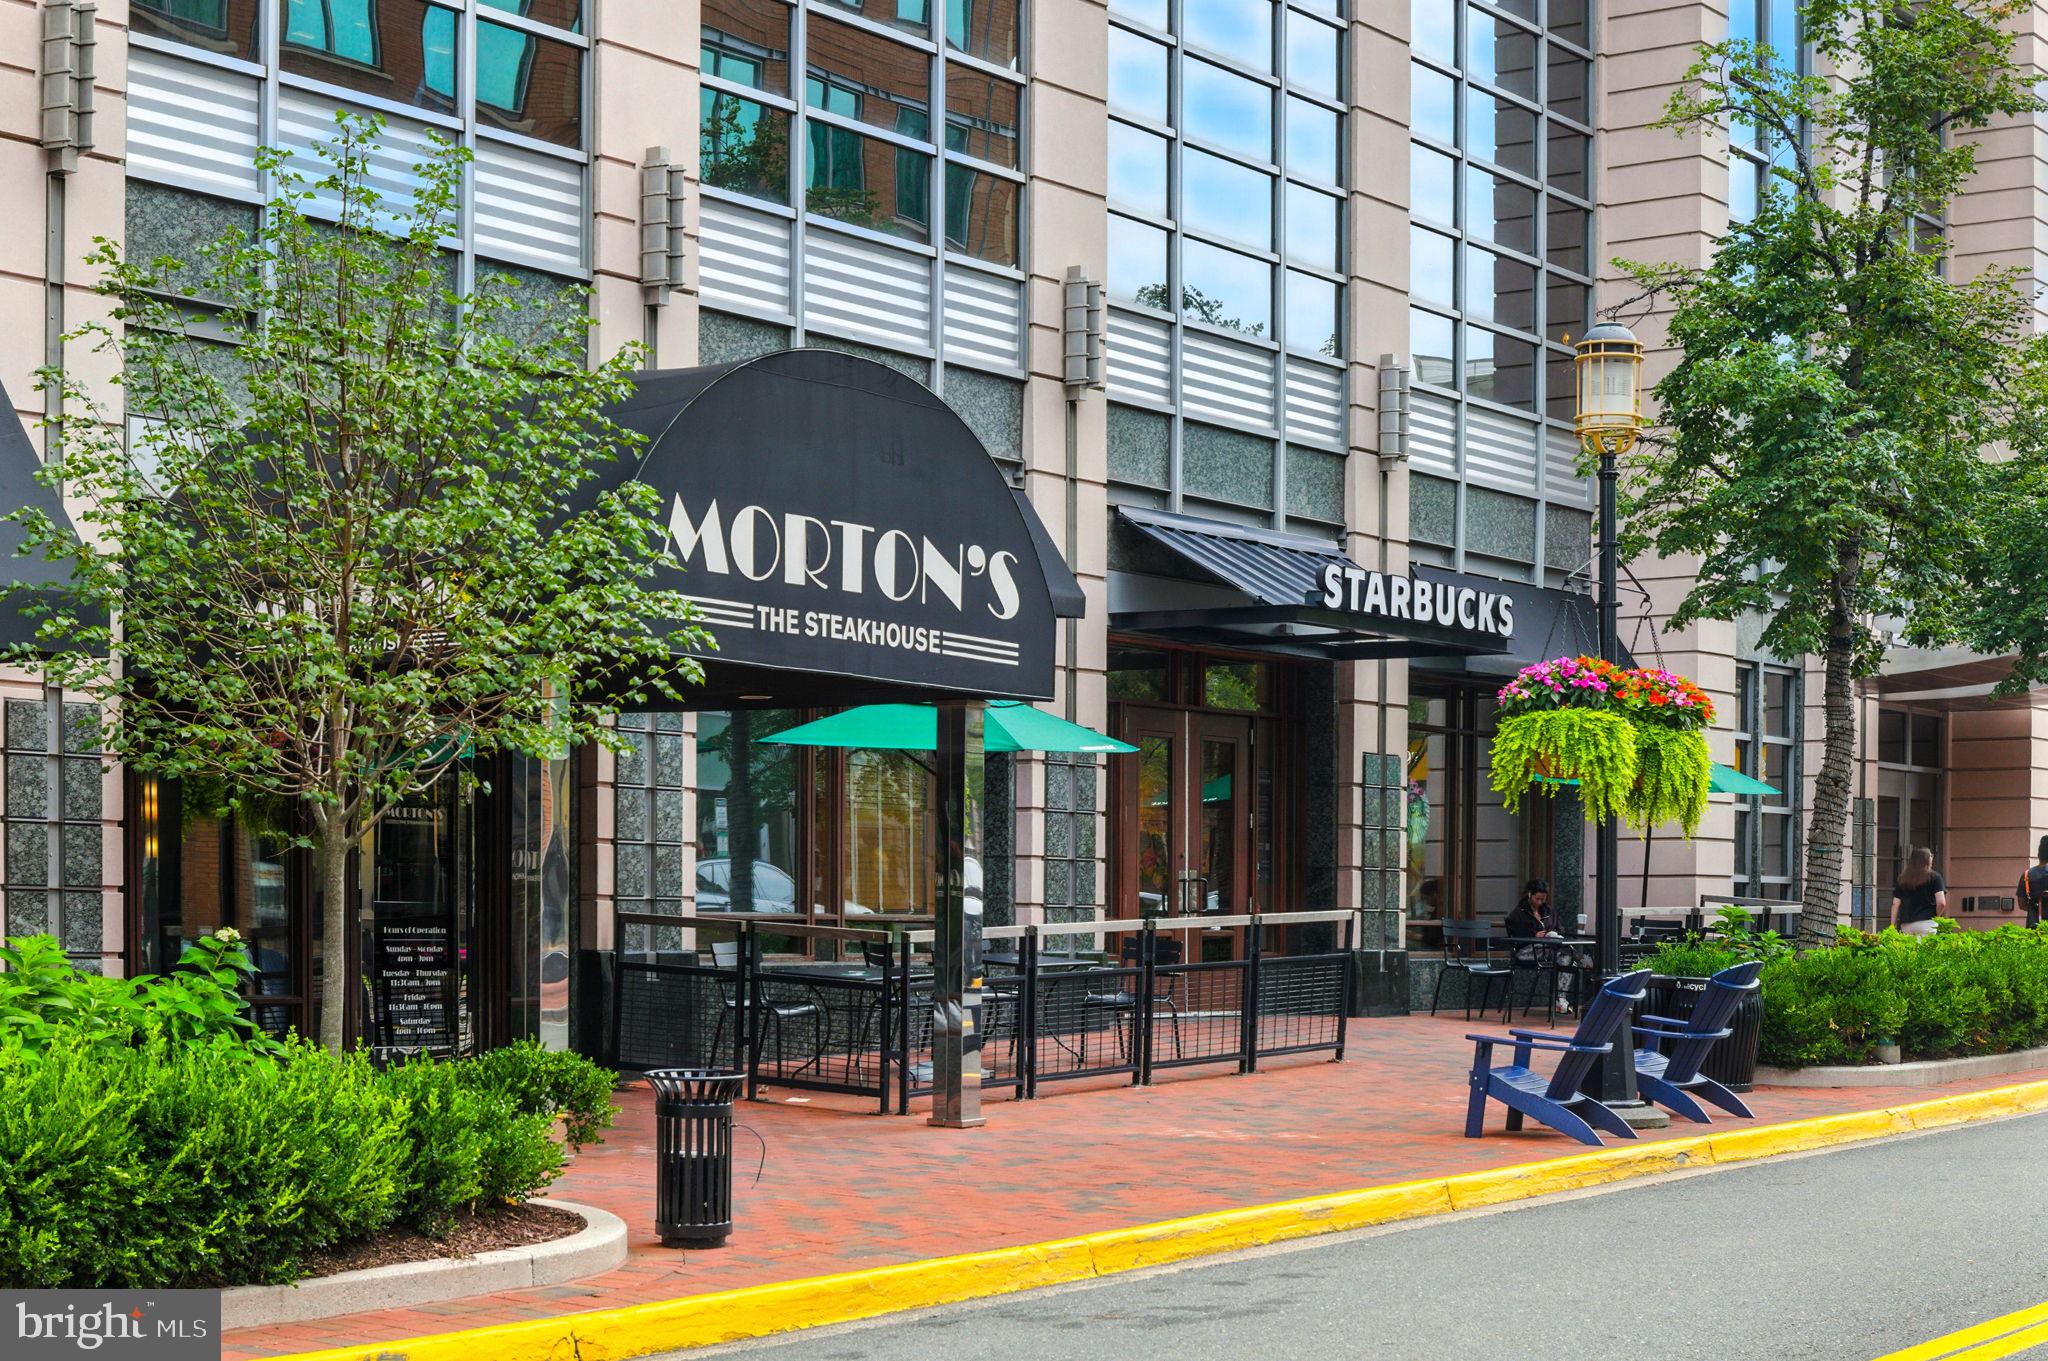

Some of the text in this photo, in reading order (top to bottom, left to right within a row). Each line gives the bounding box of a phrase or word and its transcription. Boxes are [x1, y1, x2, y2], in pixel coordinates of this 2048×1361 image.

[664, 492, 1020, 619] MORTON'S
[1321, 564, 1514, 637] STARBUCKS
[757, 604, 941, 654] THE STEAKHOUSE
[412, 926, 447, 935] Operation
[386, 945, 412, 953] Sunday
[417, 945, 443, 953] Monday
[382, 969, 410, 977] Tuesday
[415, 969, 448, 977] Thursday
[403, 993, 426, 1001] Friday
